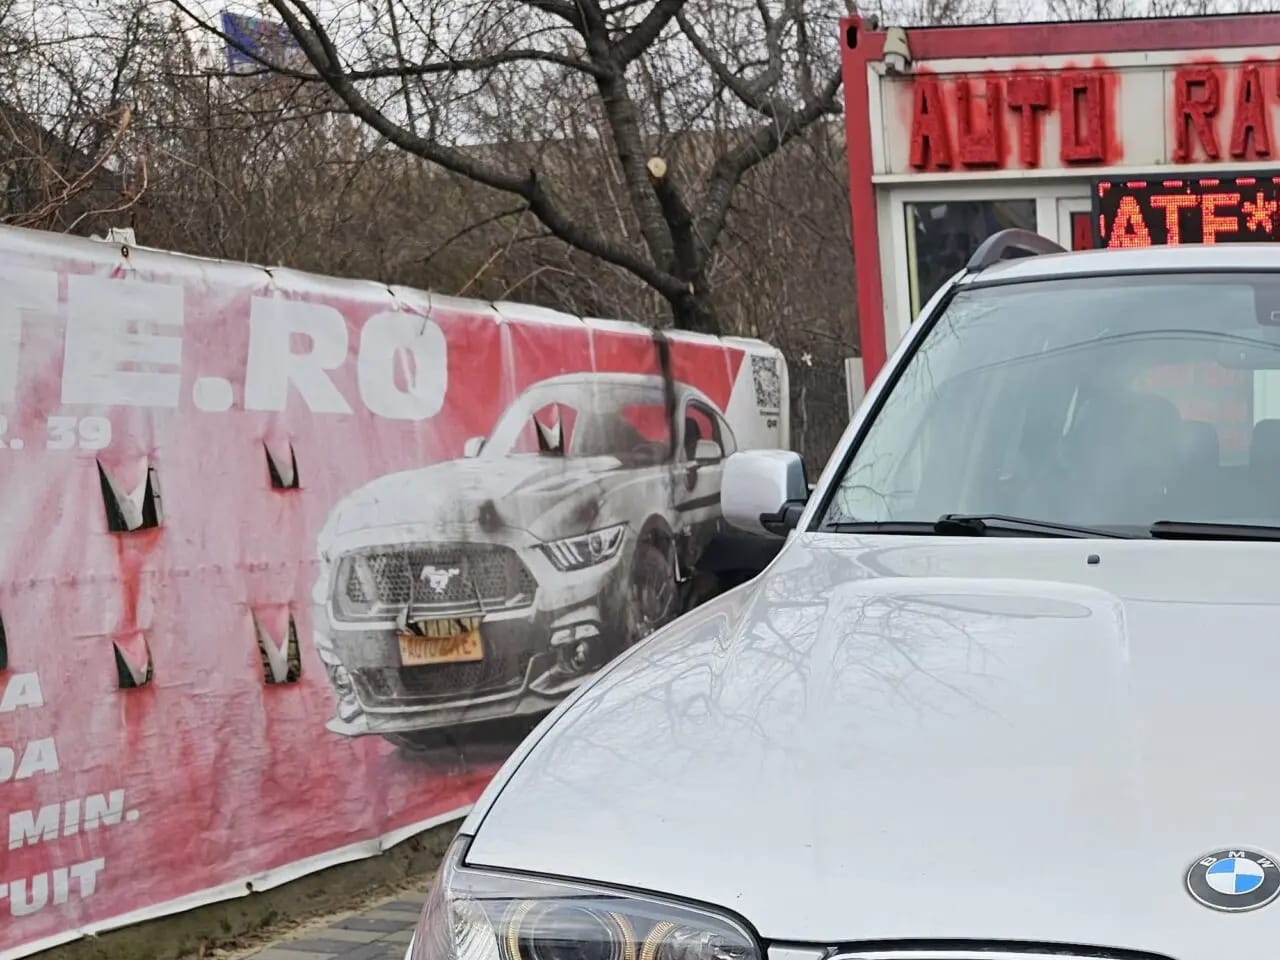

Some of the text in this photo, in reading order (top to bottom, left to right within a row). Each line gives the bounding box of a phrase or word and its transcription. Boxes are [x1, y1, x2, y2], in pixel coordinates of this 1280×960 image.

[909, 69, 1107, 169] AUTO
[46, 415, 113, 450] 39
[8, 789, 140, 851] MIN.
[0, 857, 105, 916] UIT
